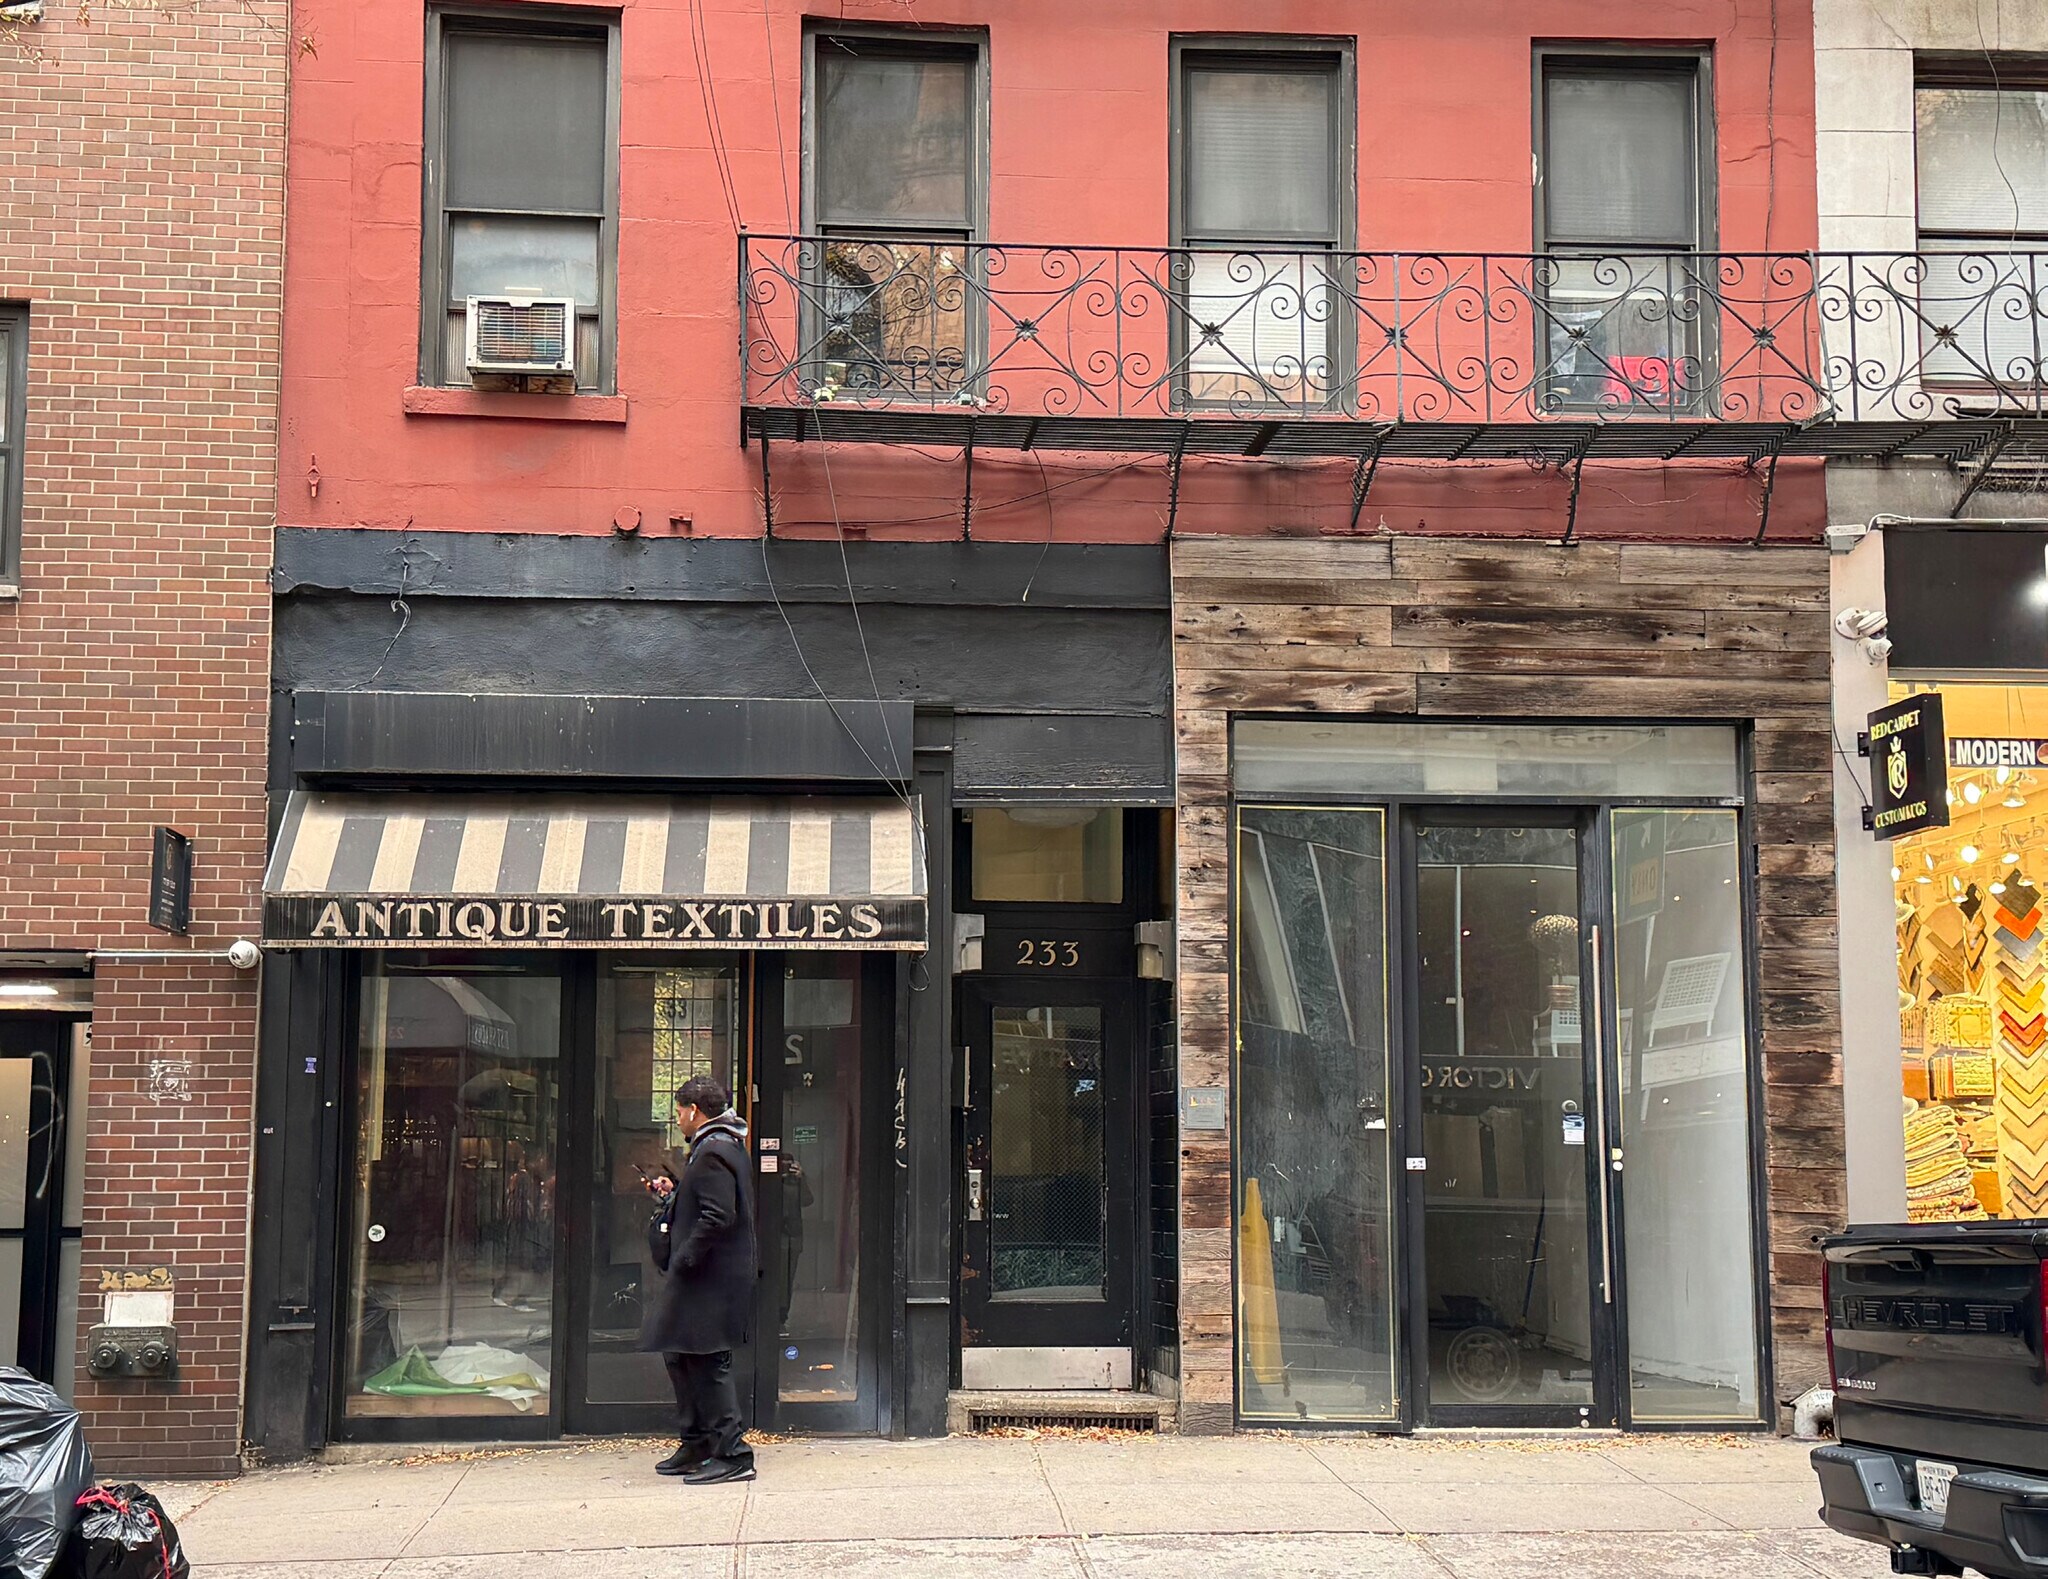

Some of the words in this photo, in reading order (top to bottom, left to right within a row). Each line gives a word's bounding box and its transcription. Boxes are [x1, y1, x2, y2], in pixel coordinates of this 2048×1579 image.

[1888, 709, 1921, 734] CARPET
[1956, 739, 2036, 765] MODERN
[310, 901, 570, 944] ANTIQUE
[600, 902, 882, 939] TEXTILES
[1017, 939, 1079, 967] 233
[1831, 1299, 2014, 1332] CHEVROLET
